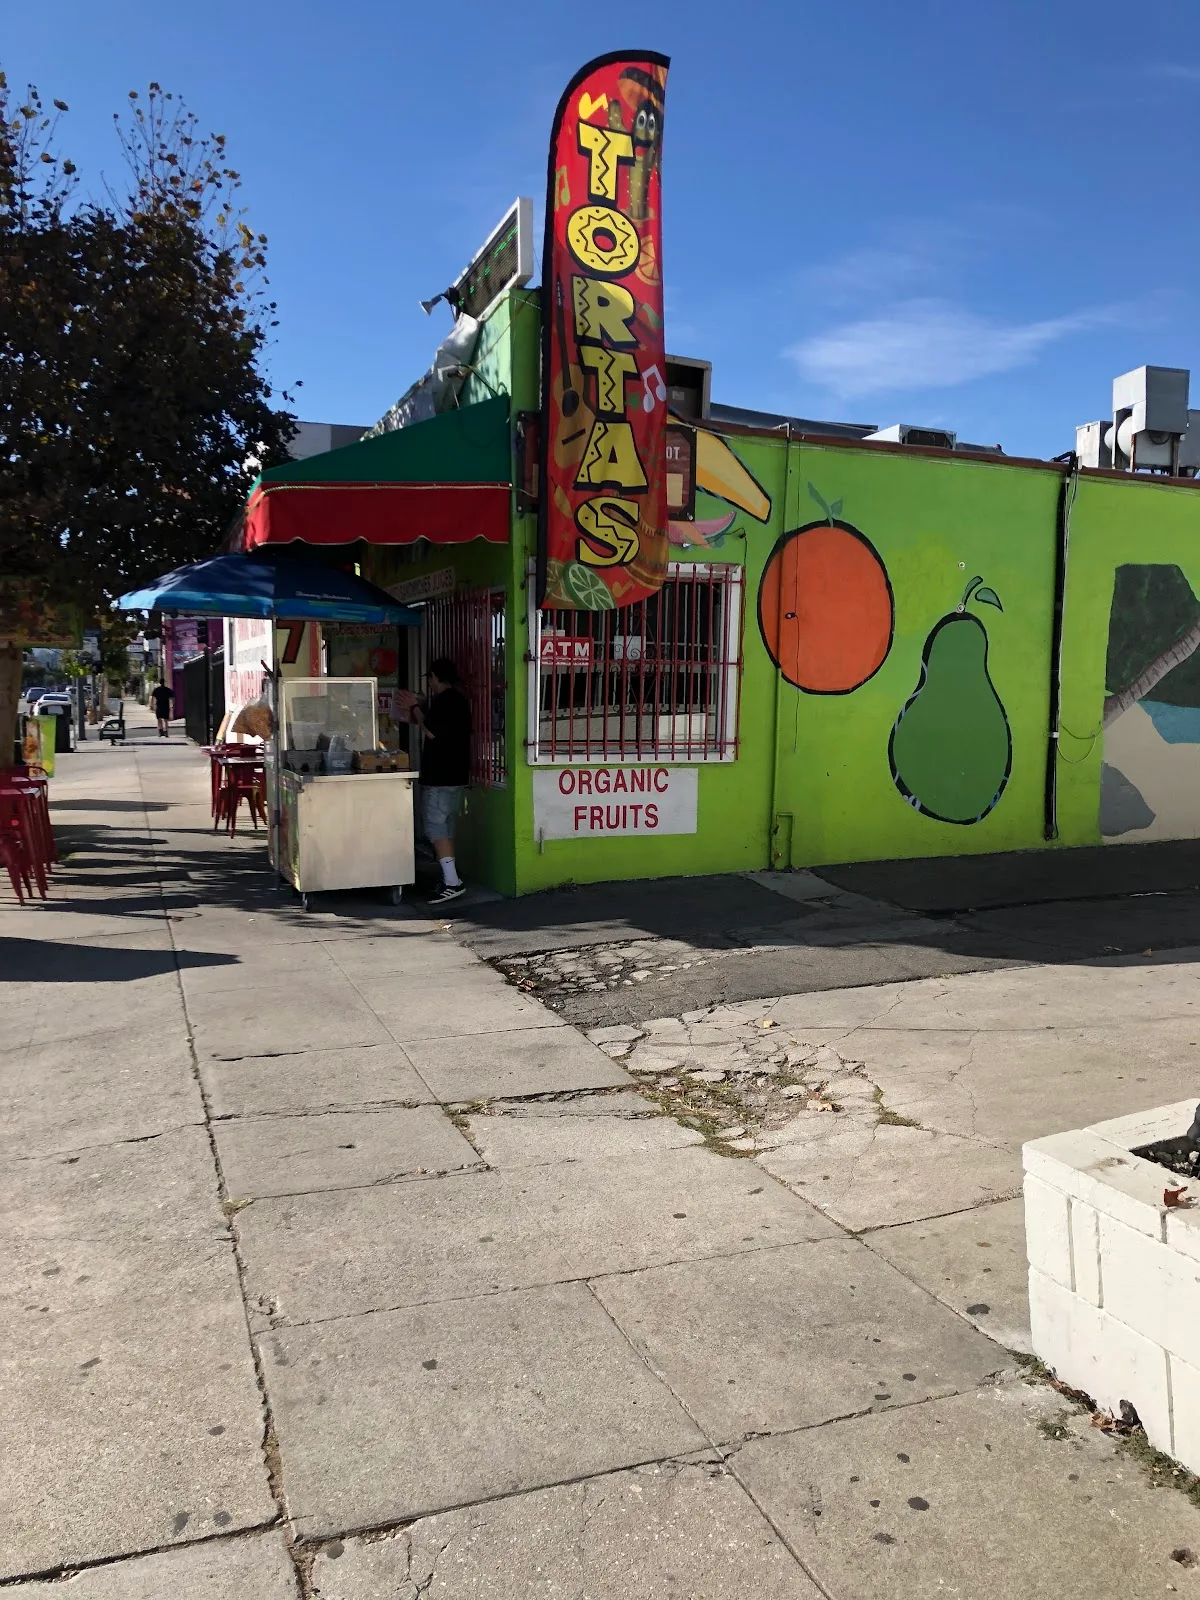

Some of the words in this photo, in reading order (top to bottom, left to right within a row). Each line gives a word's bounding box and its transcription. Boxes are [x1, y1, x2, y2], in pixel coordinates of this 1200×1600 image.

[566, 119, 648, 567] TORTAS
[666, 446, 680, 460] OT
[432, 568, 453, 590] JUICES
[541, 641, 590, 657] ATM
[558, 767, 669, 795] ORGANIC
[574, 803, 659, 831] FRUITS
